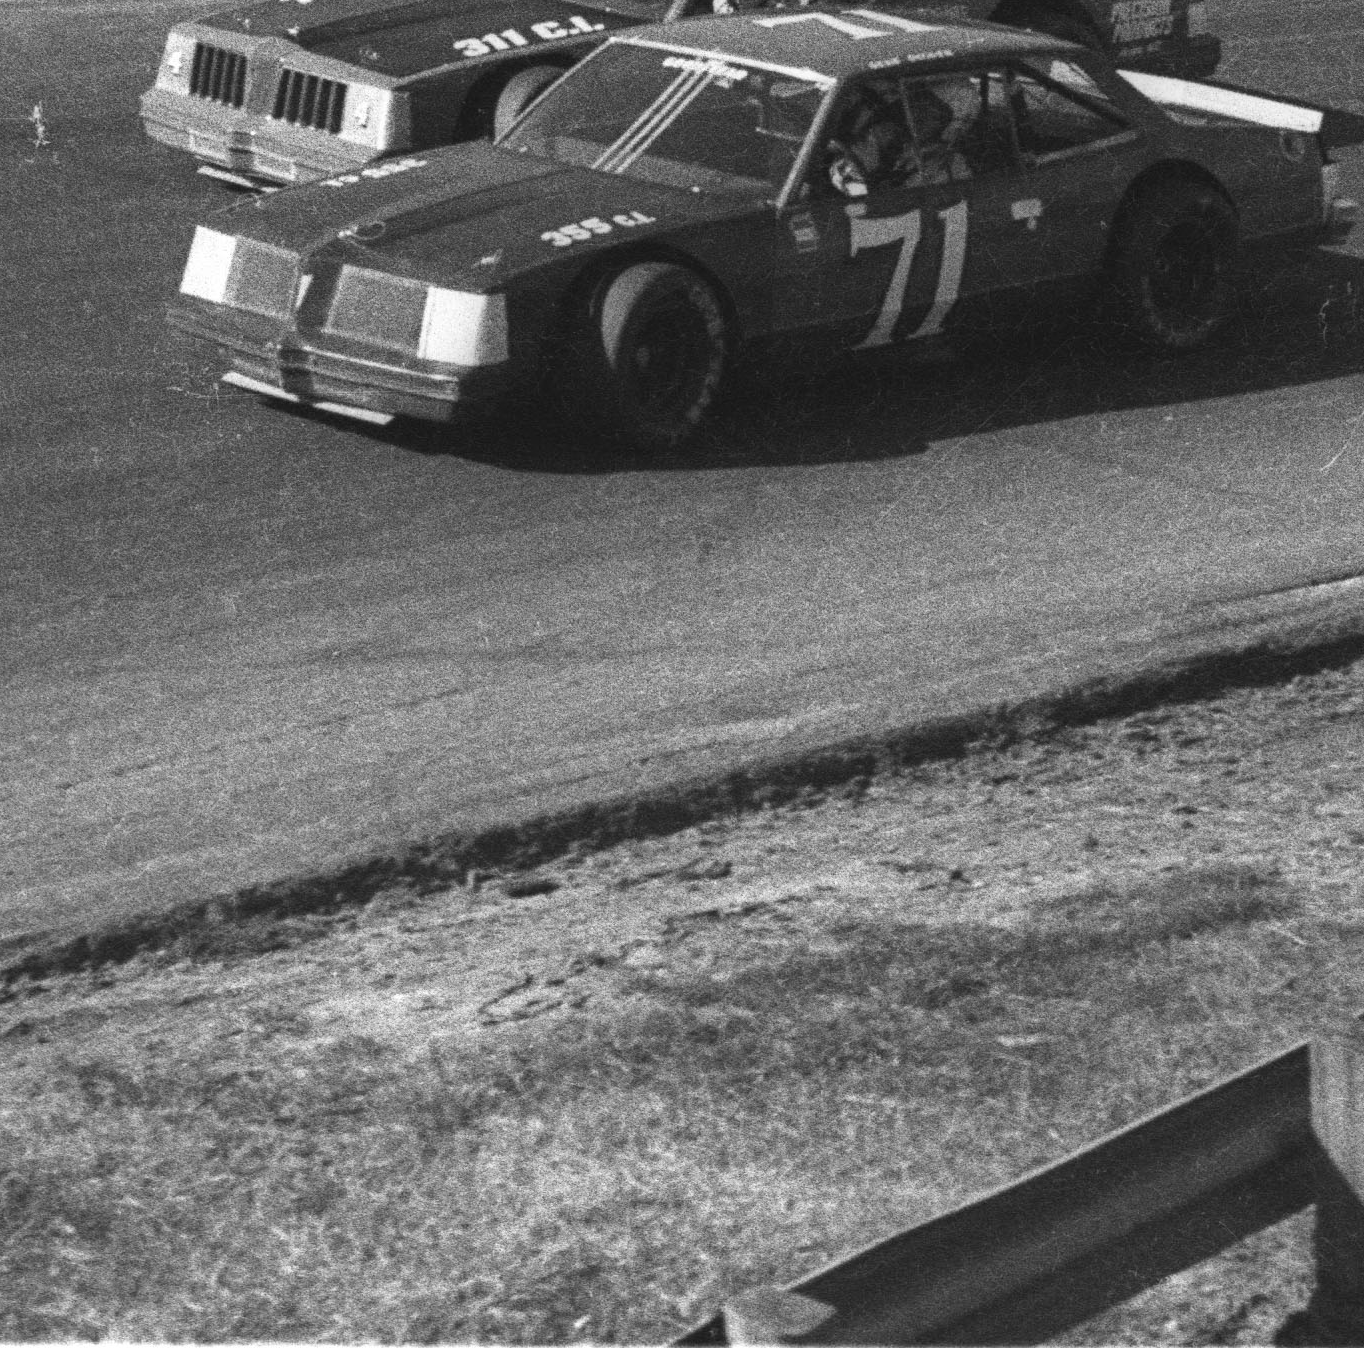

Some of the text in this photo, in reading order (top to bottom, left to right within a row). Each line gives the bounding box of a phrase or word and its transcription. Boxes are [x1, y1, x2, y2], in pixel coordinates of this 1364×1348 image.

[752, 8, 945, 40] 71
[452, 28, 528, 57] 311
[539, 216, 613, 247] 355
[849, 199, 969, 351] 71
